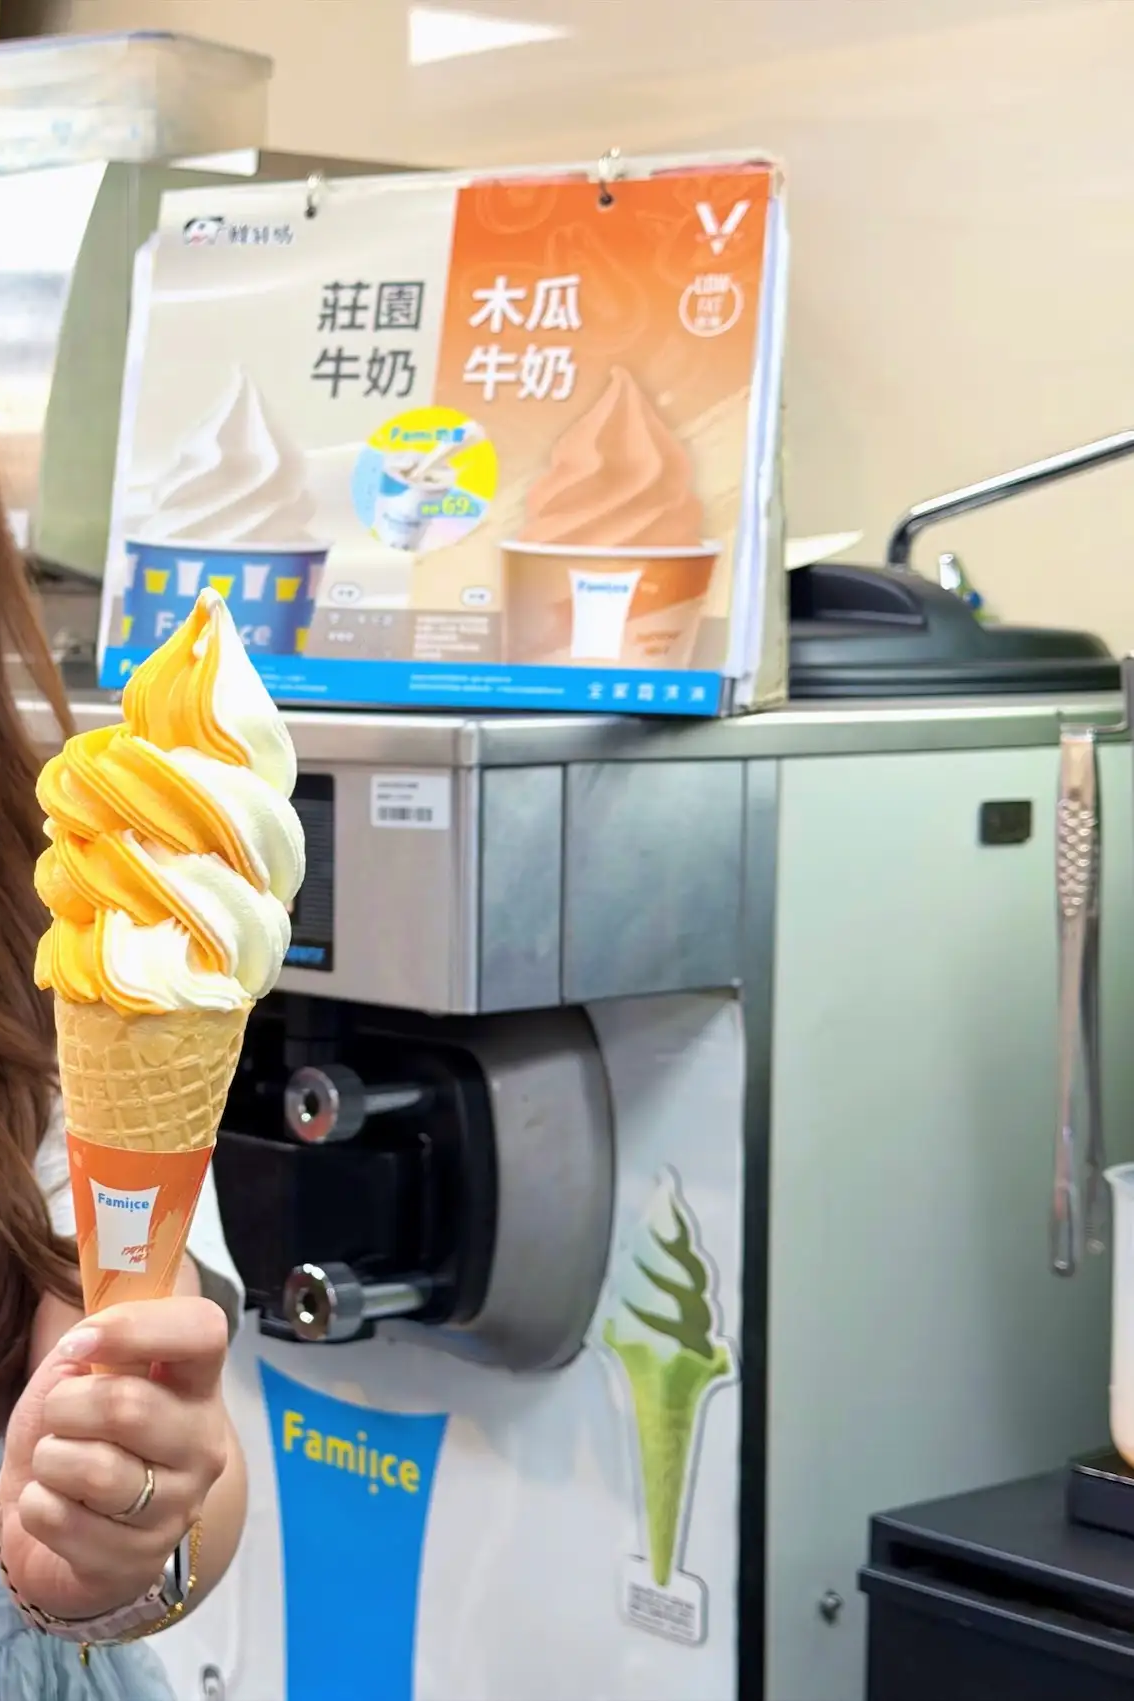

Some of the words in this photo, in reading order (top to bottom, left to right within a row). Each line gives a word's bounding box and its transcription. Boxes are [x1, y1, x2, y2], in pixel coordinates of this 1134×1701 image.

[317, 280, 425, 332] 莊園
[468, 274, 583, 333] 木瓜
[310, 346, 417, 398] 牛奶
[462, 343, 577, 401] 牛奶
[98, 1192, 150, 1213] Famiice
[283, 1409, 421, 1496] Famiice
